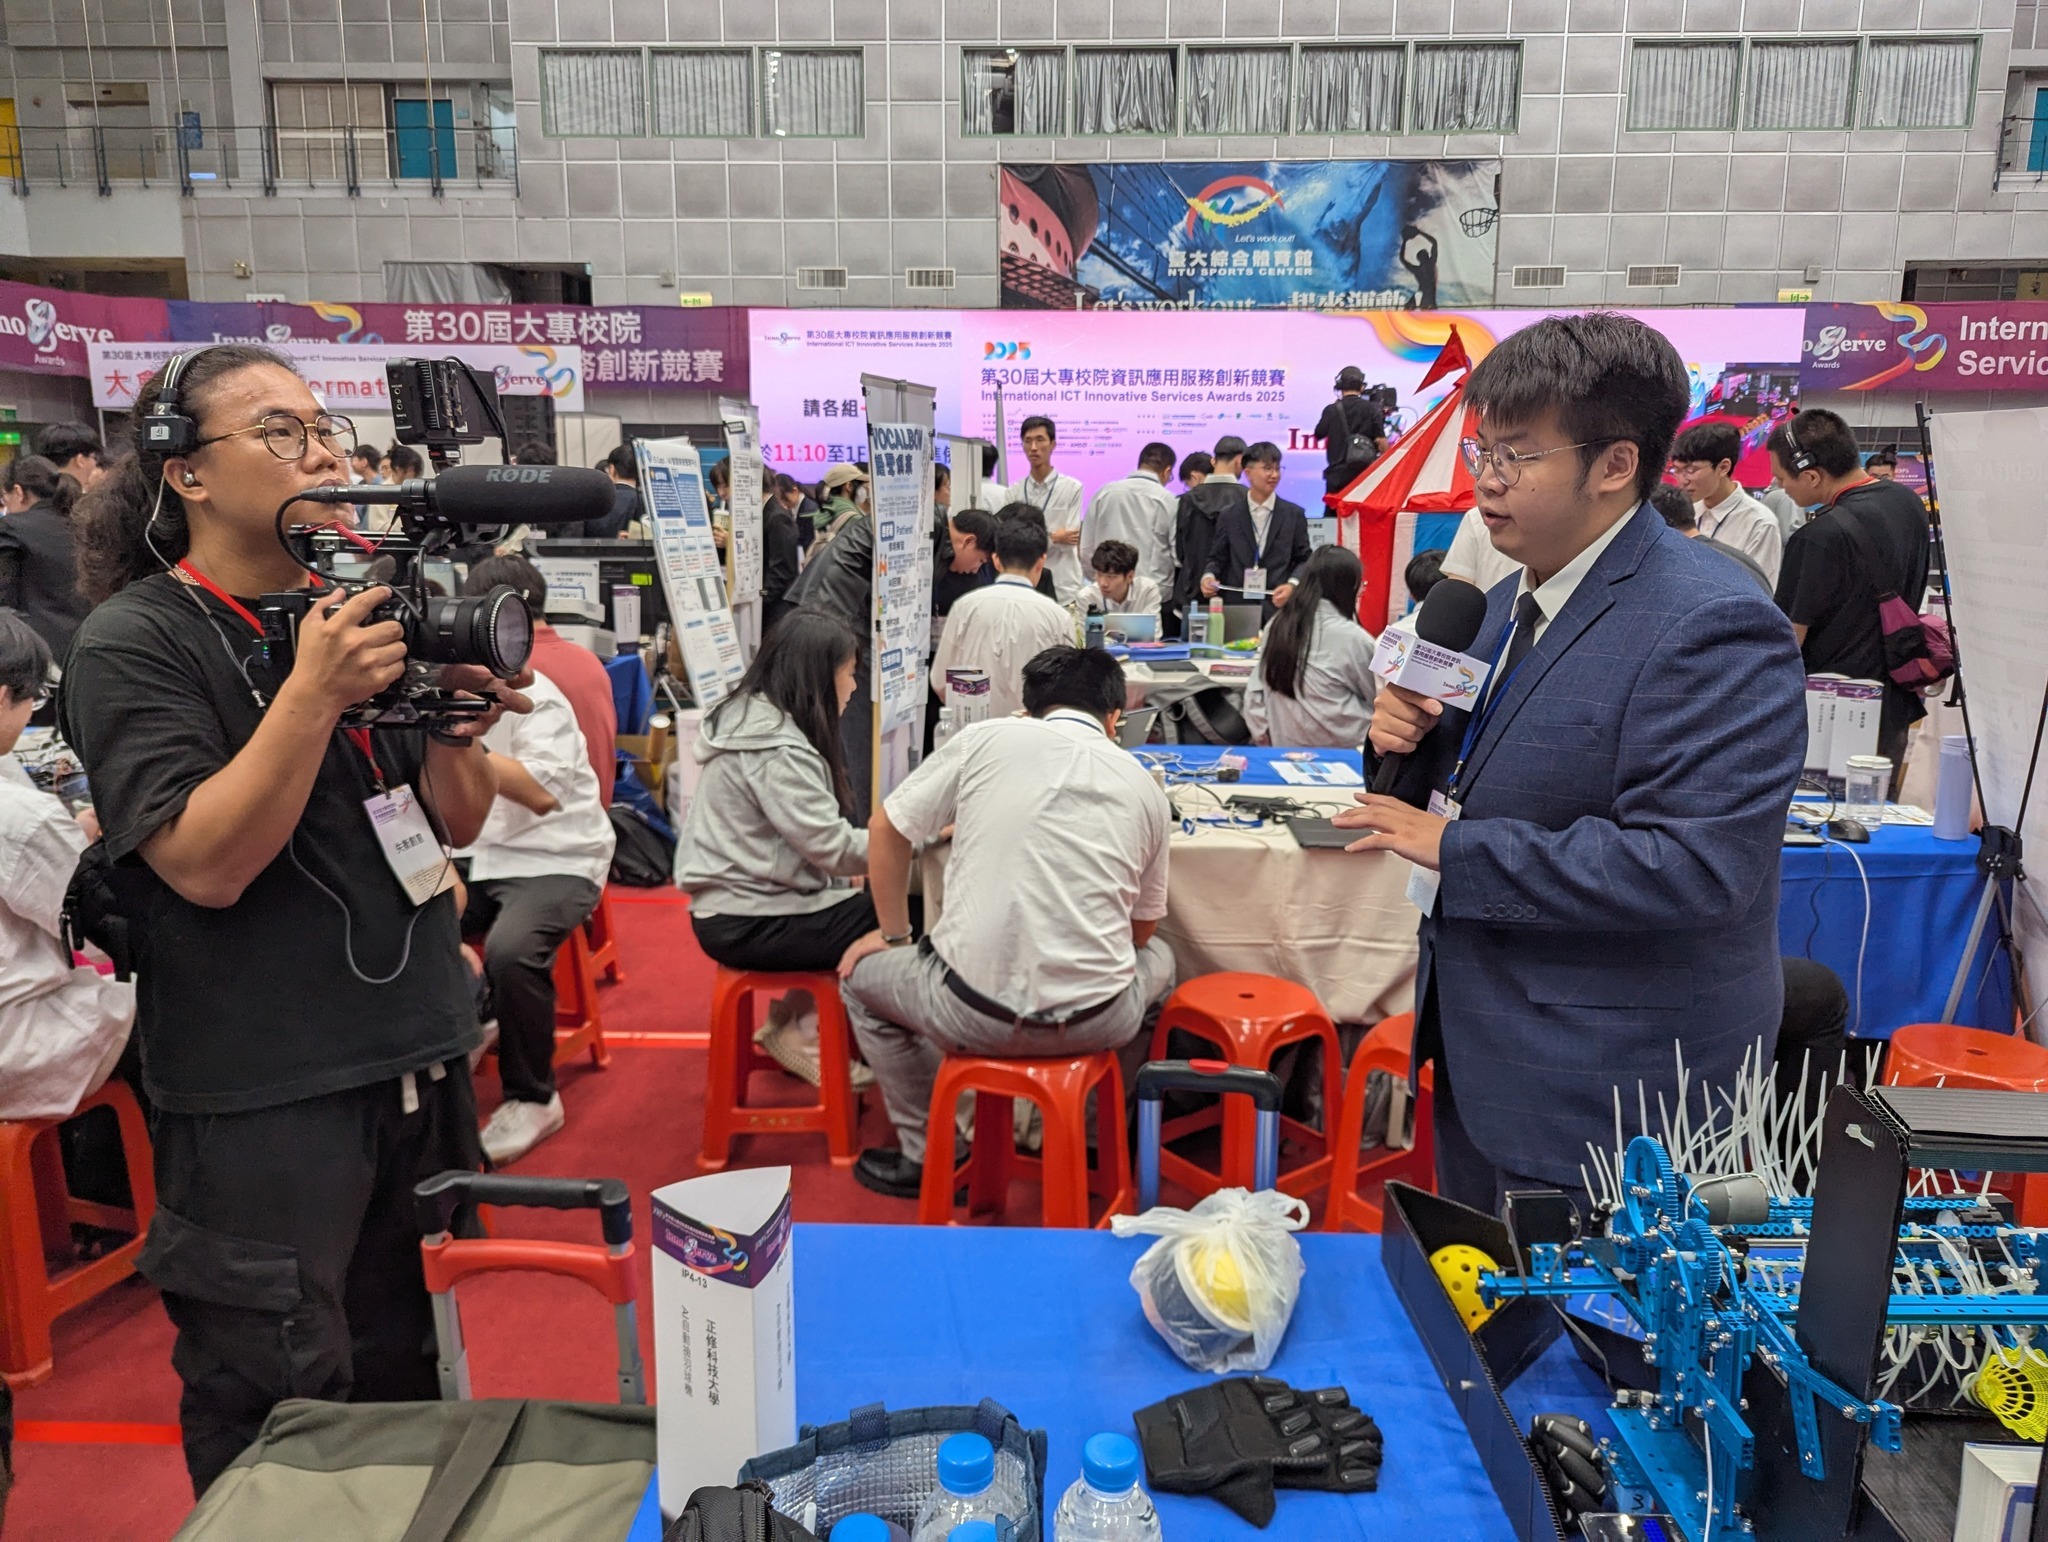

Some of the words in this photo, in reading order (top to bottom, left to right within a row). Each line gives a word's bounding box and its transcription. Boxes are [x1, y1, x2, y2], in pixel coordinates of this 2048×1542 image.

[1235, 234, 1255, 243] Let's
[1257, 234, 1278, 243] work
[1279, 234, 1296, 243] out!
[1168, 250, 1313, 268] 臺大綜合體育館
[1168, 268, 1195, 276] NTU
[1200, 268, 1254, 277] SPORTS
[1259, 268, 1313, 276] CENTER
[1138, 289, 1205, 311] work
[404, 310, 642, 345] 第30屆大專校院
[1812, 361, 1840, 369] Awards
[1060, 390, 1081, 402] ICT
[1084, 390, 1147, 402] Innovative
[1151, 390, 1204, 402] Services
[1206, 390, 1253, 402] Awards
[1256, 390, 1286, 403] 2025
[157, 404, 166, 416] 2
[803, 399, 858, 418] 請各組
[705, 1319, 720, 1405] 正修科技大學
